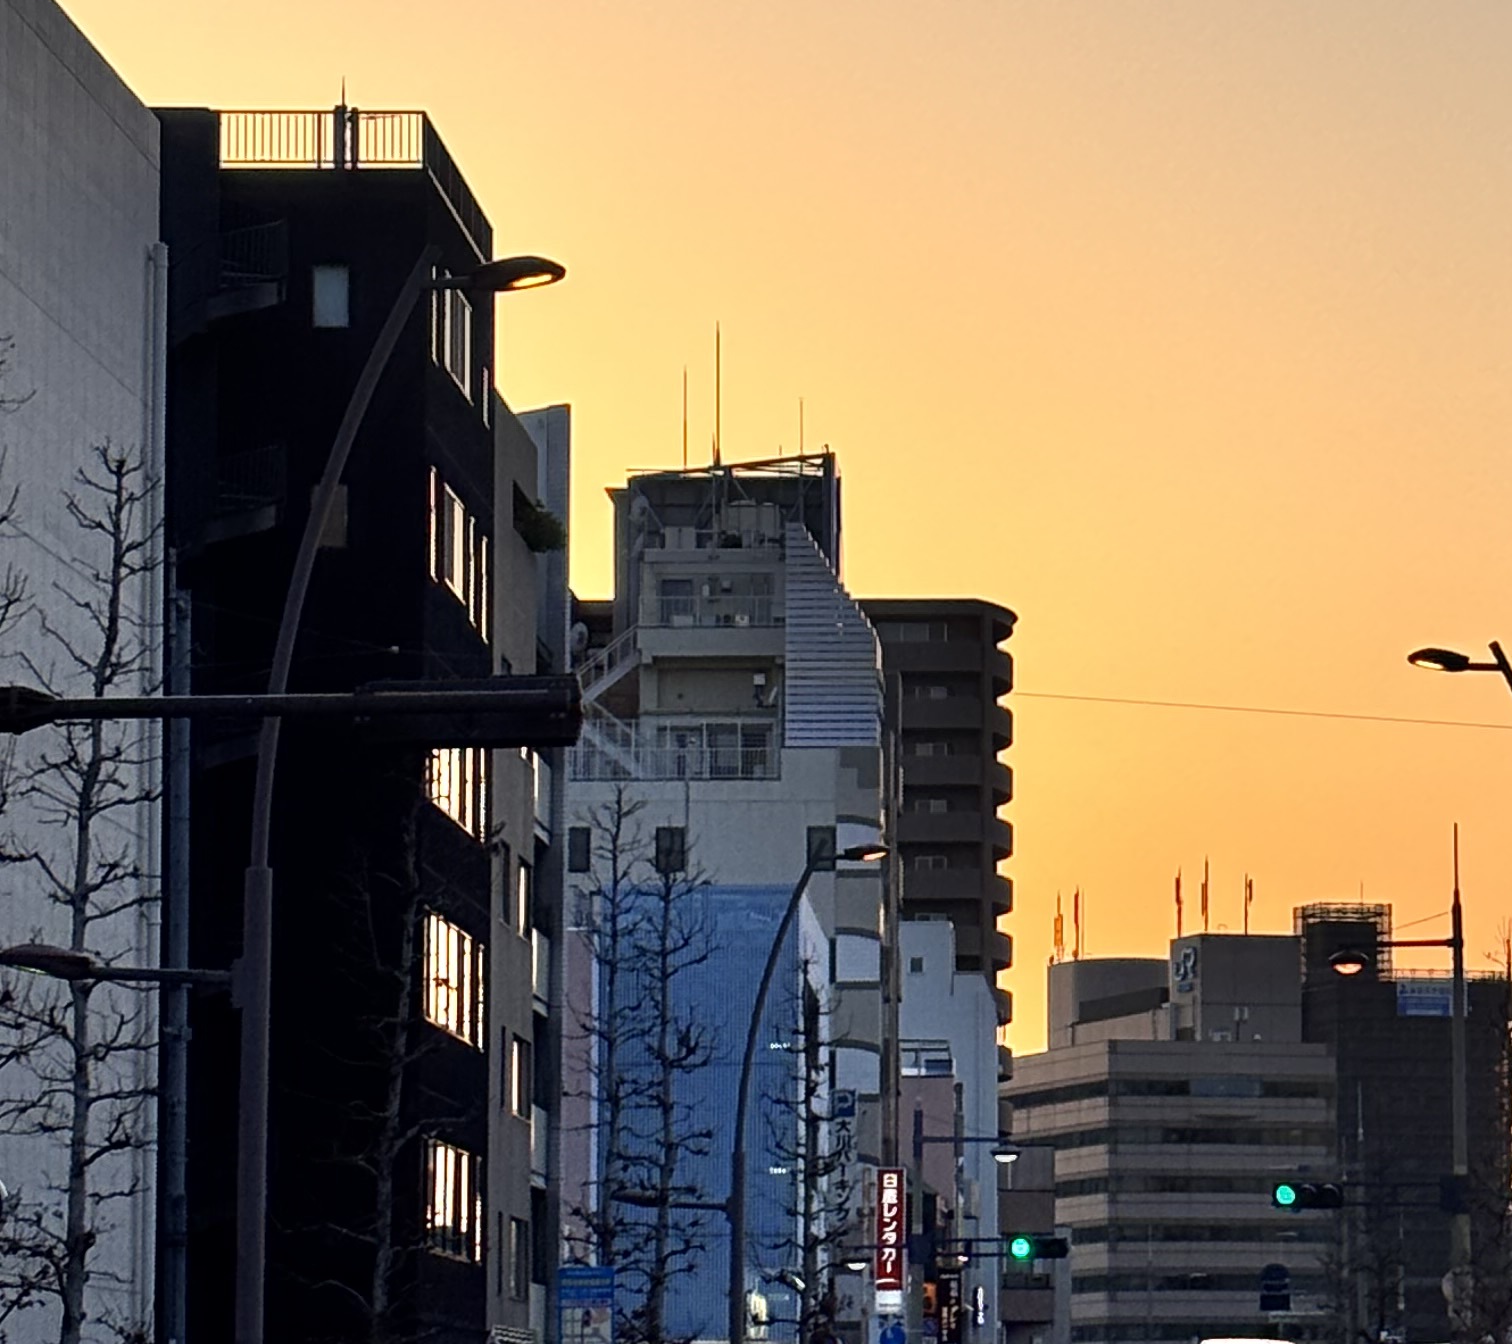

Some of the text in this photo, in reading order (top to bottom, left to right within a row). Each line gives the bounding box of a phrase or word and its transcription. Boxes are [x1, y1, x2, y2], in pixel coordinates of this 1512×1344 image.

[1173, 947, 1196, 980] JR
[881, 1173, 898, 1274] 日産レンタカー
